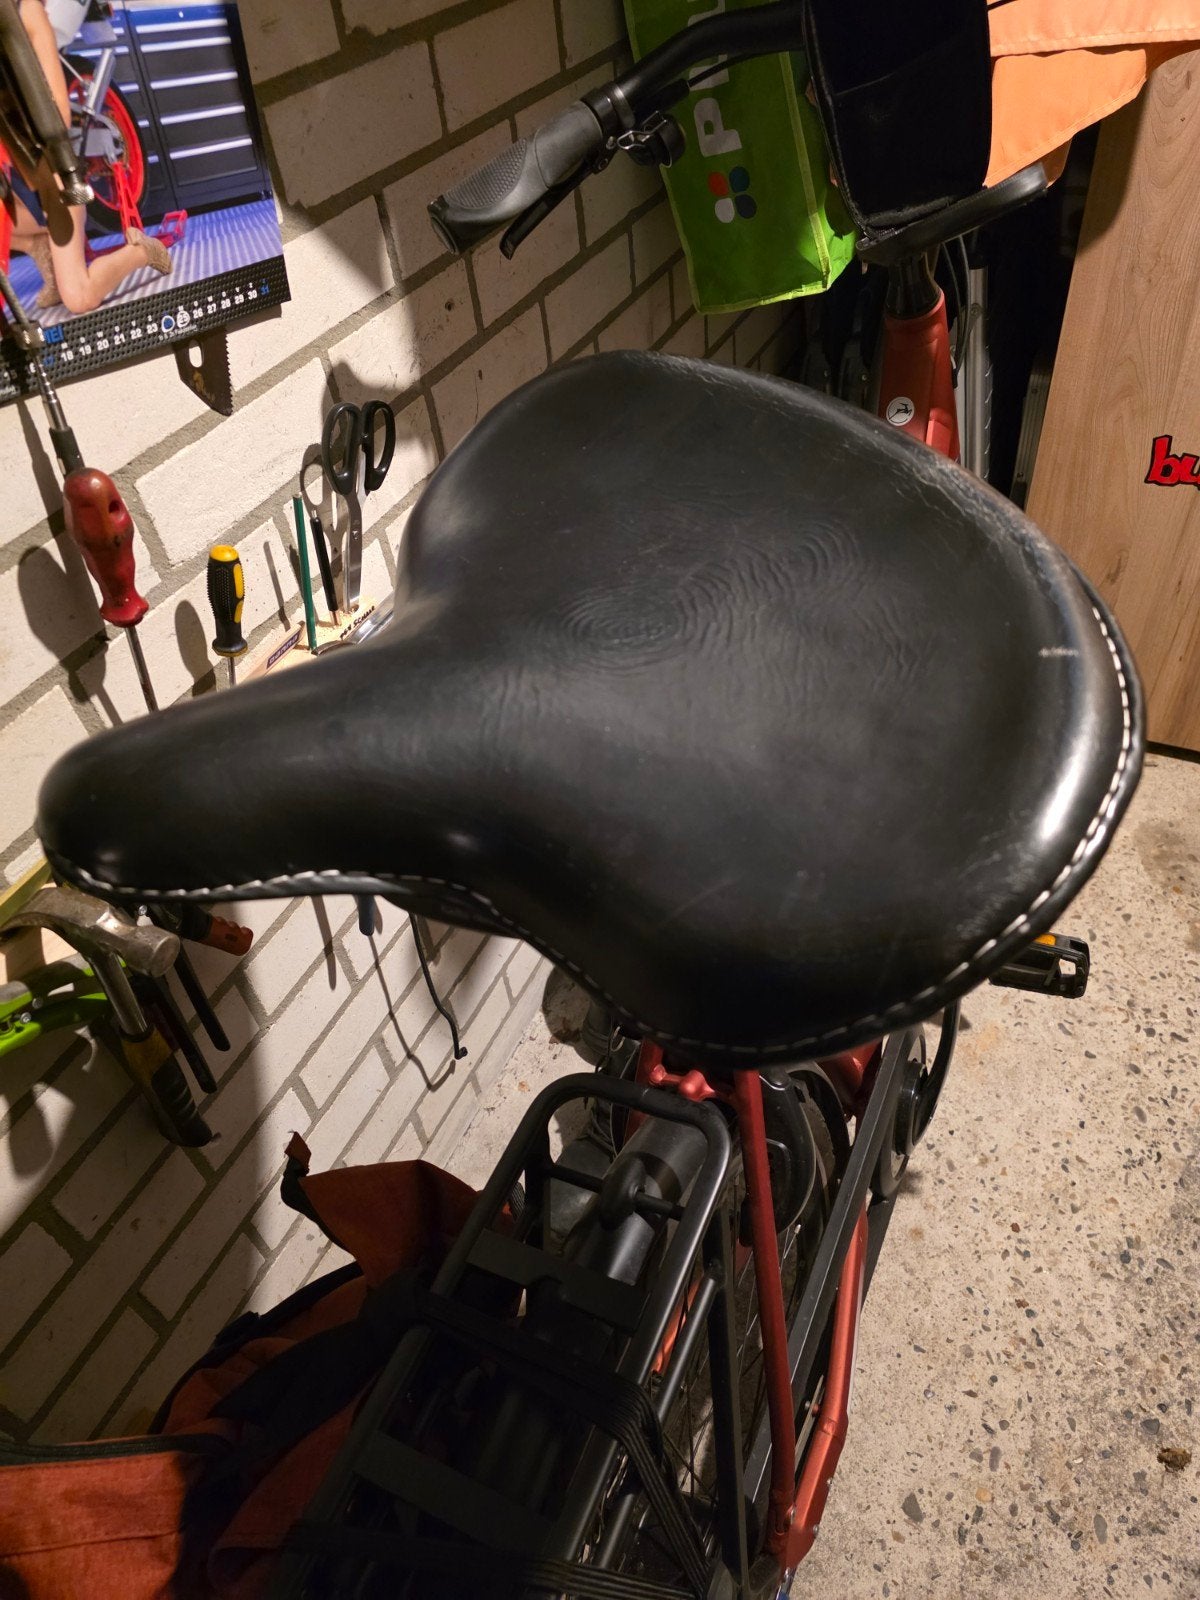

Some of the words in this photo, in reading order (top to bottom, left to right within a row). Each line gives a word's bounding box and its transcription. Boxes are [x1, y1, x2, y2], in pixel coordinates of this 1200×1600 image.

[60, 350, 74, 362] 18
[79, 345, 92, 356] 19
[96, 339, 110, 351] 20
[113, 333, 126, 345] 21
[130, 328, 142, 340] 22
[146, 322, 158, 334] 23
[193, 307, 204, 319] 26
[207, 303, 217, 314] 27
[221, 298, 231, 309] 28
[234, 293, 245, 305] 29
[247, 289, 258, 300] 30
